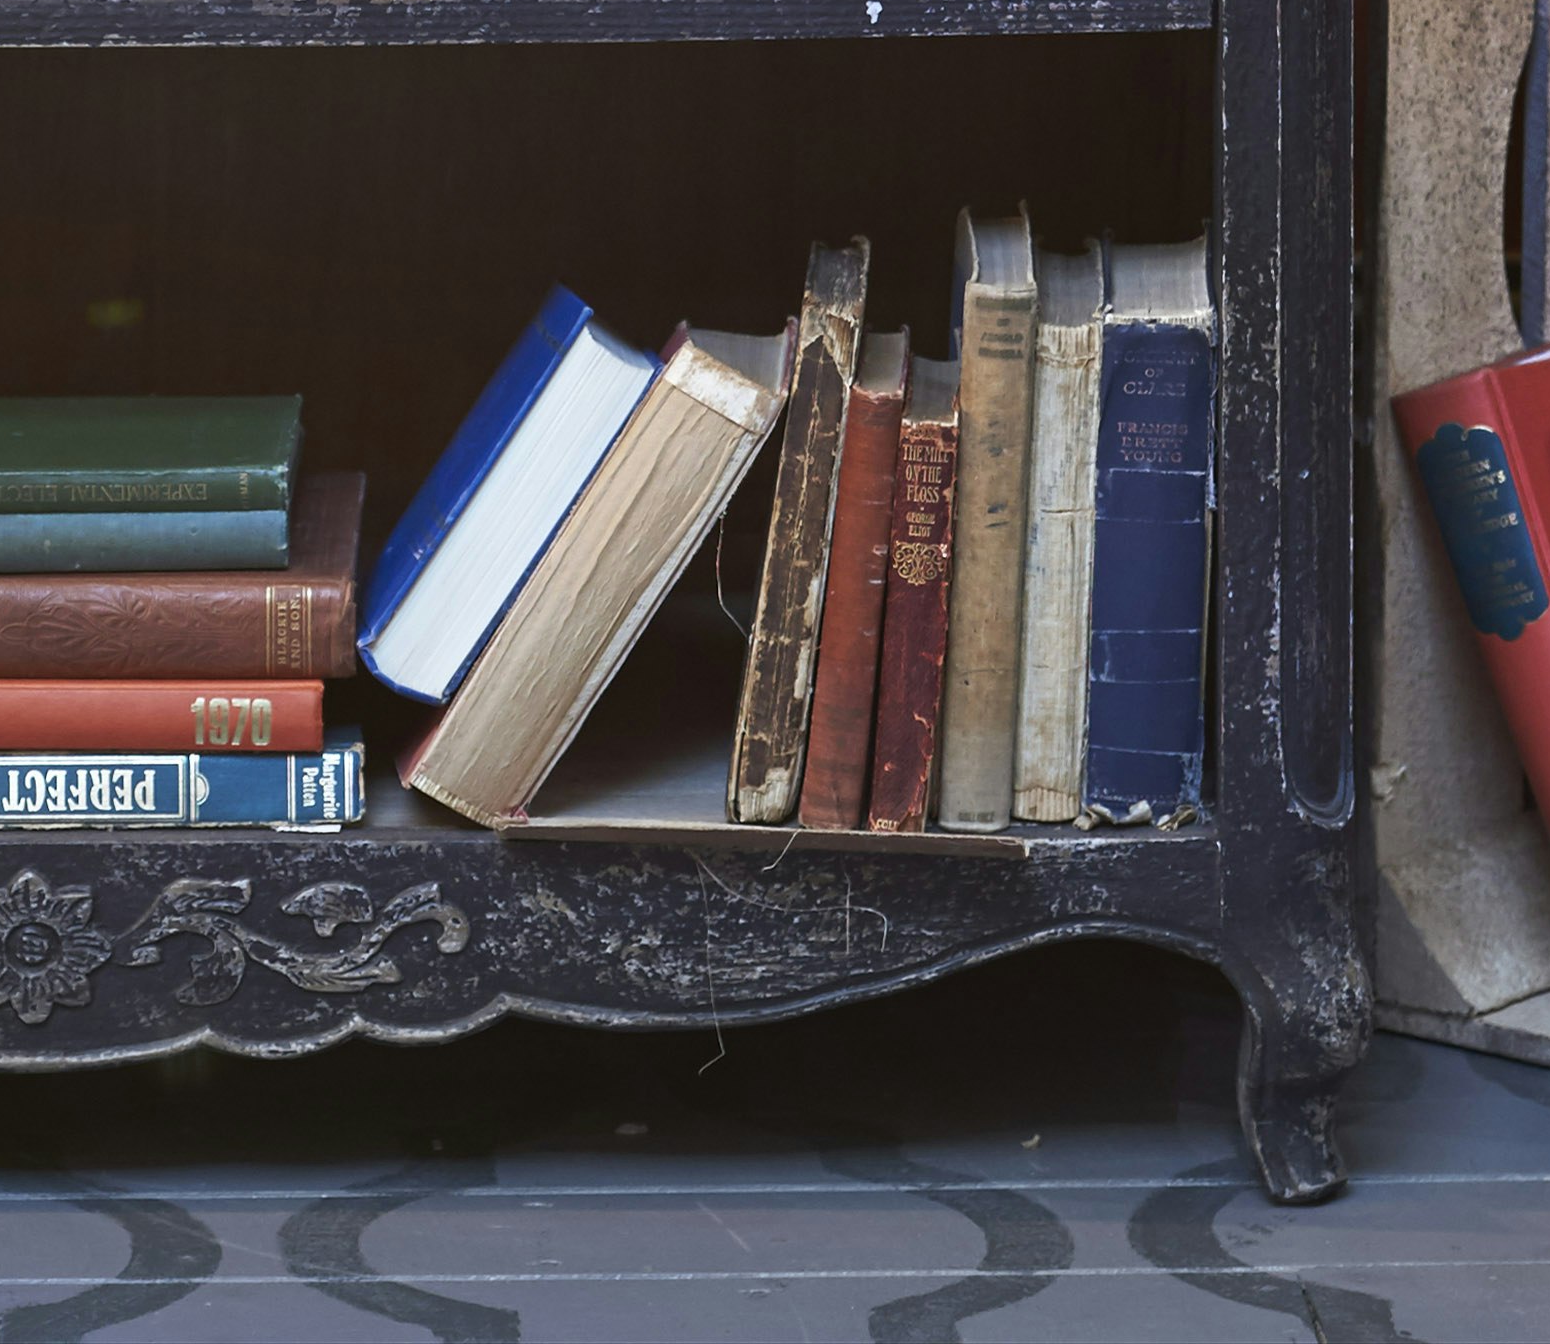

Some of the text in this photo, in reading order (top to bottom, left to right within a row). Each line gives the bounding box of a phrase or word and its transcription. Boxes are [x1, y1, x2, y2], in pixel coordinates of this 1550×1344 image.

[1117, 421, 1189, 436] FRANCIS
[902, 443, 949, 464] THE MILL
[1121, 436, 1184, 449] BRETT
[1120, 449, 1183, 463] YOUNG
[921, 464, 942, 484] THE
[69, 481, 208, 504] EXPERIMENTAL
[906, 484, 940, 504] FLOSS
[908, 525, 932, 538] ELIOT
[276, 599, 286, 665] BLACKIE
[291, 637, 300, 668] AND
[191, 696, 273, 747] 1970
[1, 768, 157, 813] PERFECT
[302, 765, 320, 808] Patten
[321, 752, 342, 821] Marguerite
